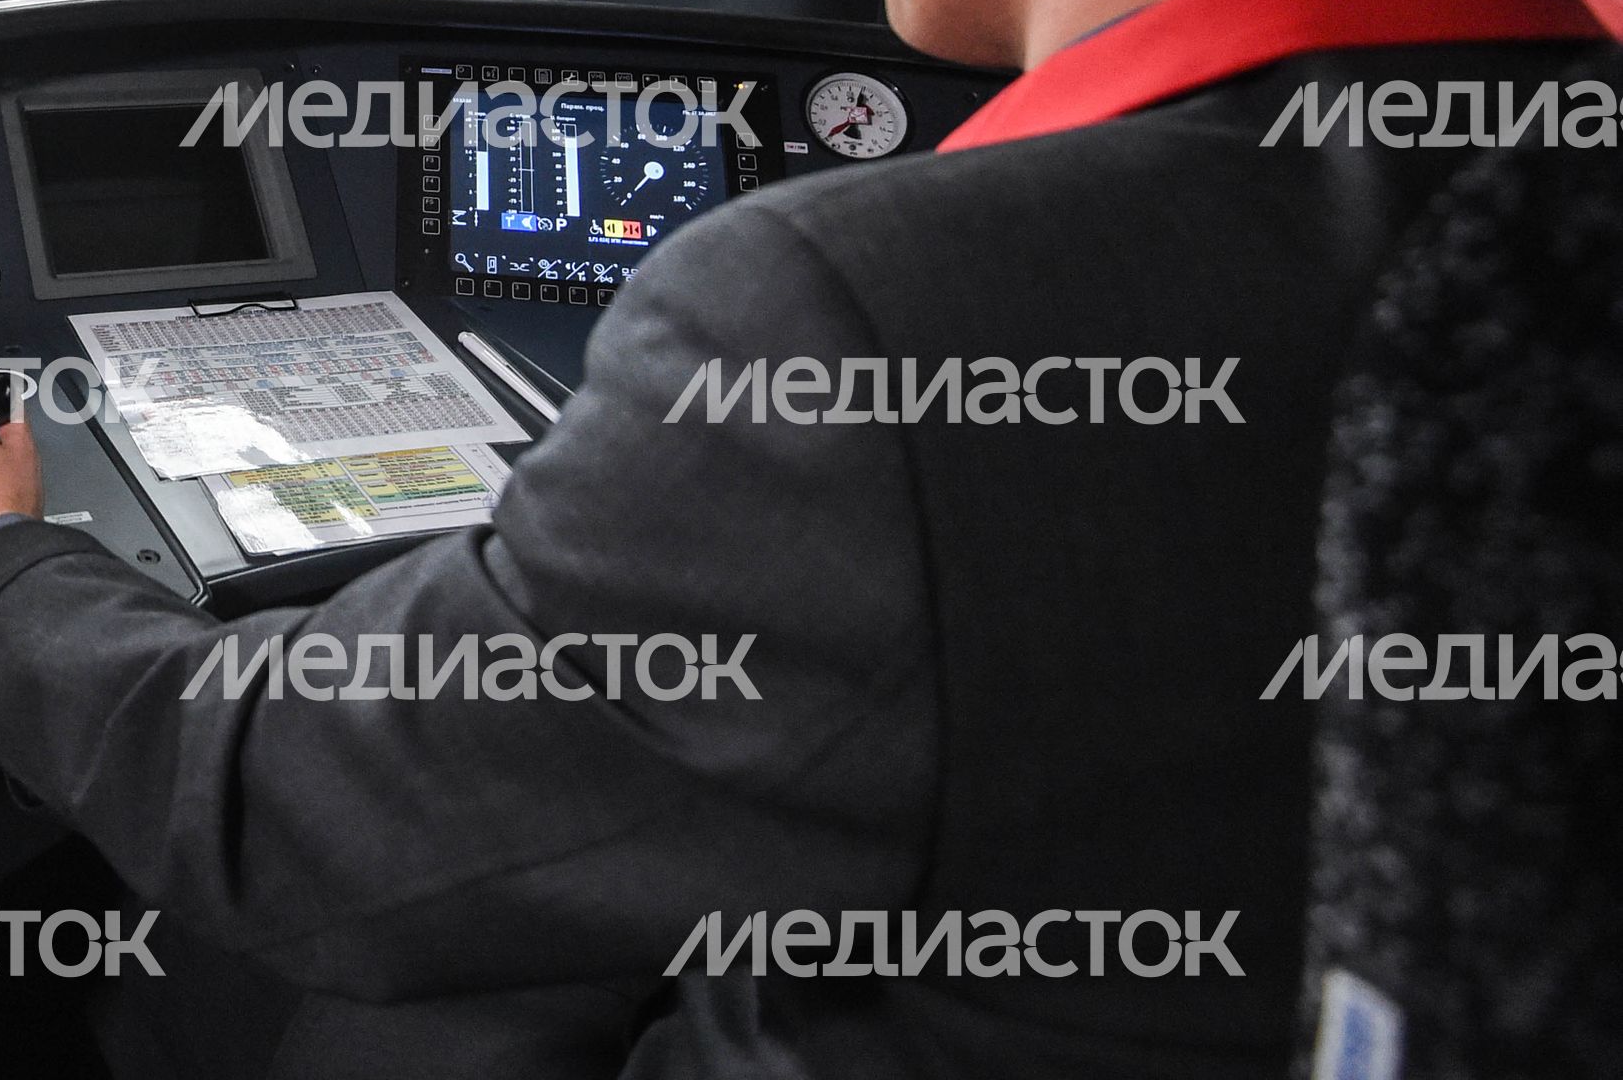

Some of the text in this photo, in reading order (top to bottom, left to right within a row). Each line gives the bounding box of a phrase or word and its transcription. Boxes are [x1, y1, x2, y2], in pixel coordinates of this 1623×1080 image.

[637, 132, 647, 141] 80
[654, 133, 669, 142] 100
[620, 141, 630, 150] 60
[672, 144, 686, 153] 120
[611, 157, 621, 165] 40
[682, 161, 696, 170] 140
[613, 175, 623, 184] 20
[682, 179, 696, 188] 160
[626, 192, 633, 200] 0
[673, 194, 686, 203] 180
